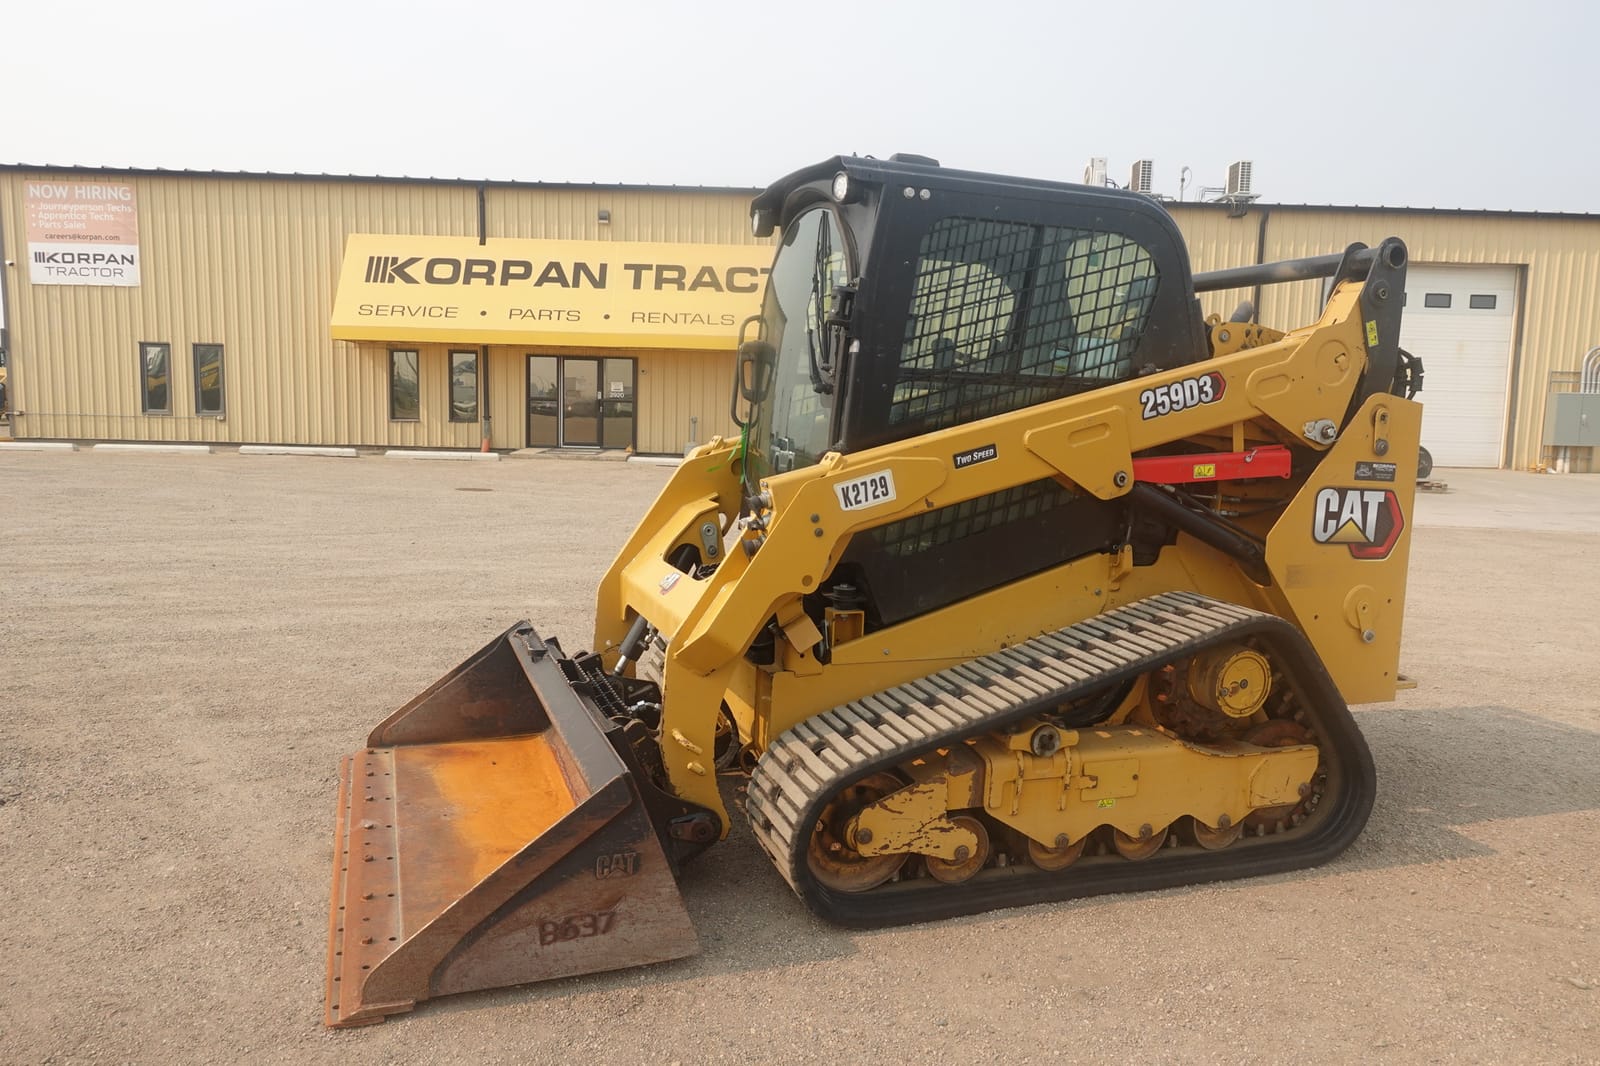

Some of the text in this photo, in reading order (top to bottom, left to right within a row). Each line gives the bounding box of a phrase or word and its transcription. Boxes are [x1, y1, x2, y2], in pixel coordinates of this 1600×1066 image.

[29, 184, 132, 201] NOW HIRING
[38, 211, 114, 221] Apprentice Techs
[39, 202, 132, 214] Journeyperson Techs
[39, 220, 87, 229] Parts Sales
[45, 232, 120, 241] careers@korpan.com
[46, 251, 135, 266] KORPAN
[44, 266, 124, 278] TRACTOR
[387, 256, 772, 294] KORPAN TRAC
[358, 304, 736, 326] SERVICE PARTS RENTALS
[1140, 374, 1214, 420] 259D3
[973, 449, 994, 461] SPEED
[841, 475, 889, 508] K2729
[1313, 488, 1386, 543] CAT
[595, 852, 637, 881] CAT
[539, 911, 617, 946] B637
